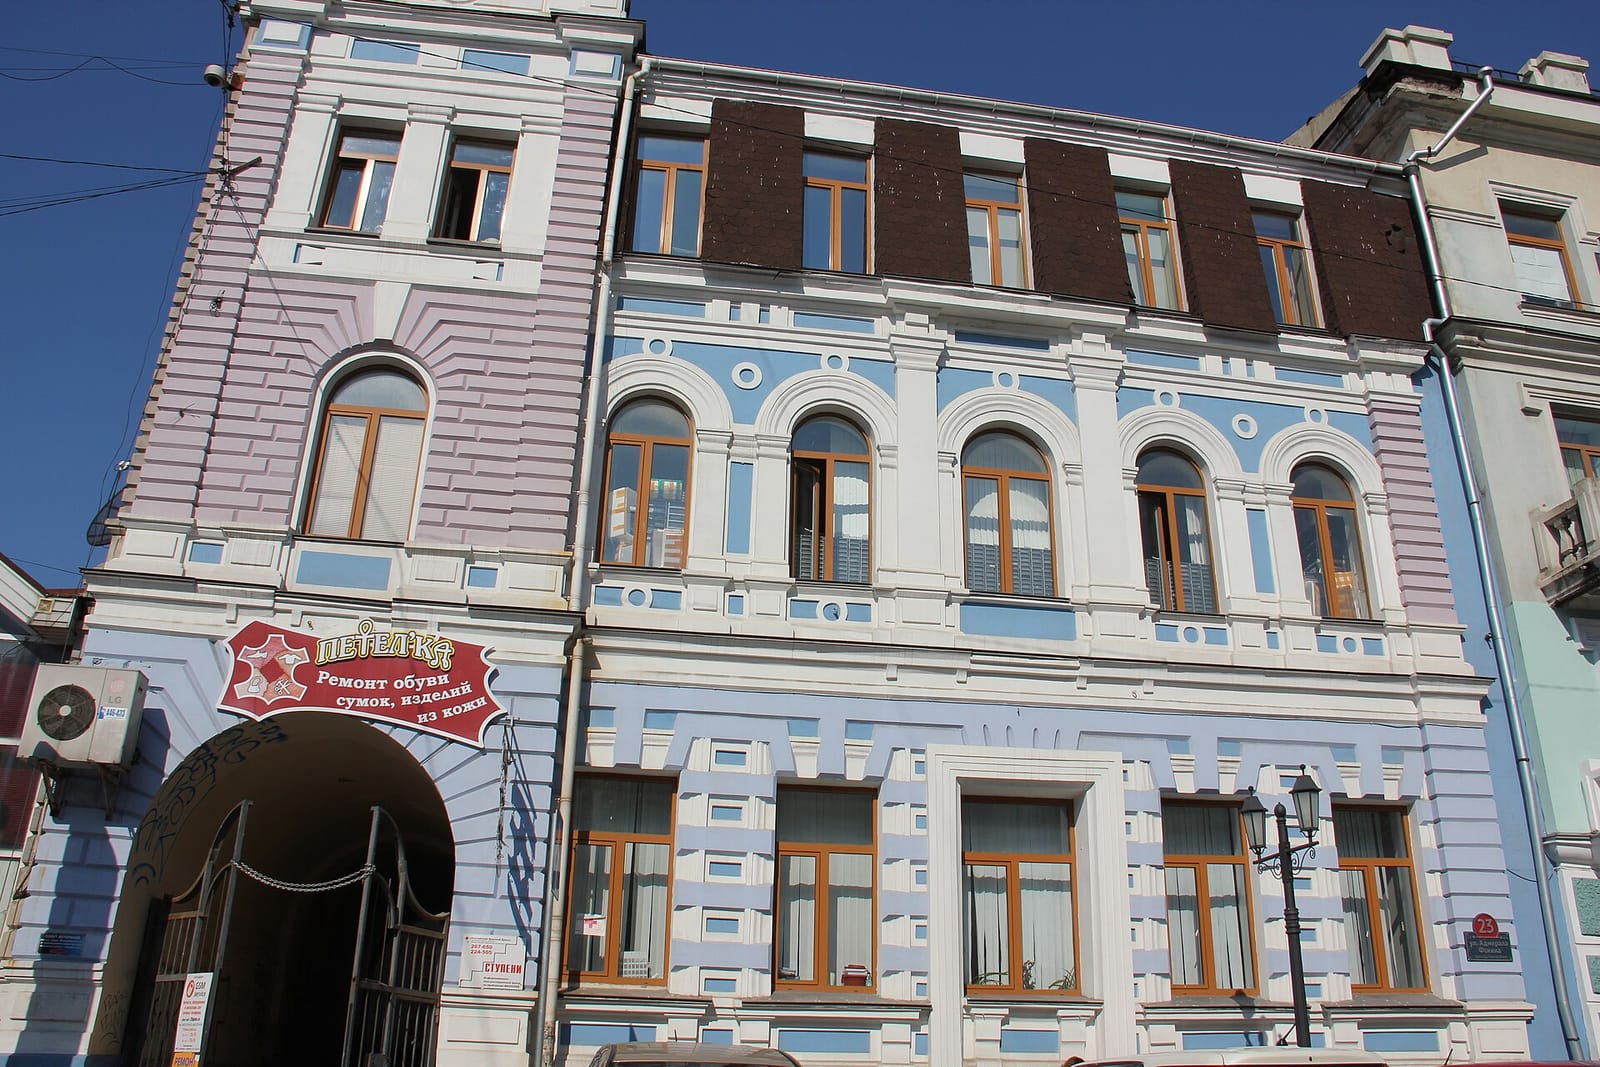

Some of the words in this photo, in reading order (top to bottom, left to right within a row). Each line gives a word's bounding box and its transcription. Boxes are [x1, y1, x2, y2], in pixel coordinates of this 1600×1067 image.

[316, 670, 389, 690] Ремонт
[393, 673, 450, 692] обуви
[108, 696, 122, 704] LG
[336, 696, 396, 710] сумок,
[400, 681, 473, 707] изделий
[416, 712, 438, 724] из
[442, 696, 488, 719] кожи
[1478, 919, 1494, 933] 23
[485, 964, 522, 974] СТУПЕНИ
